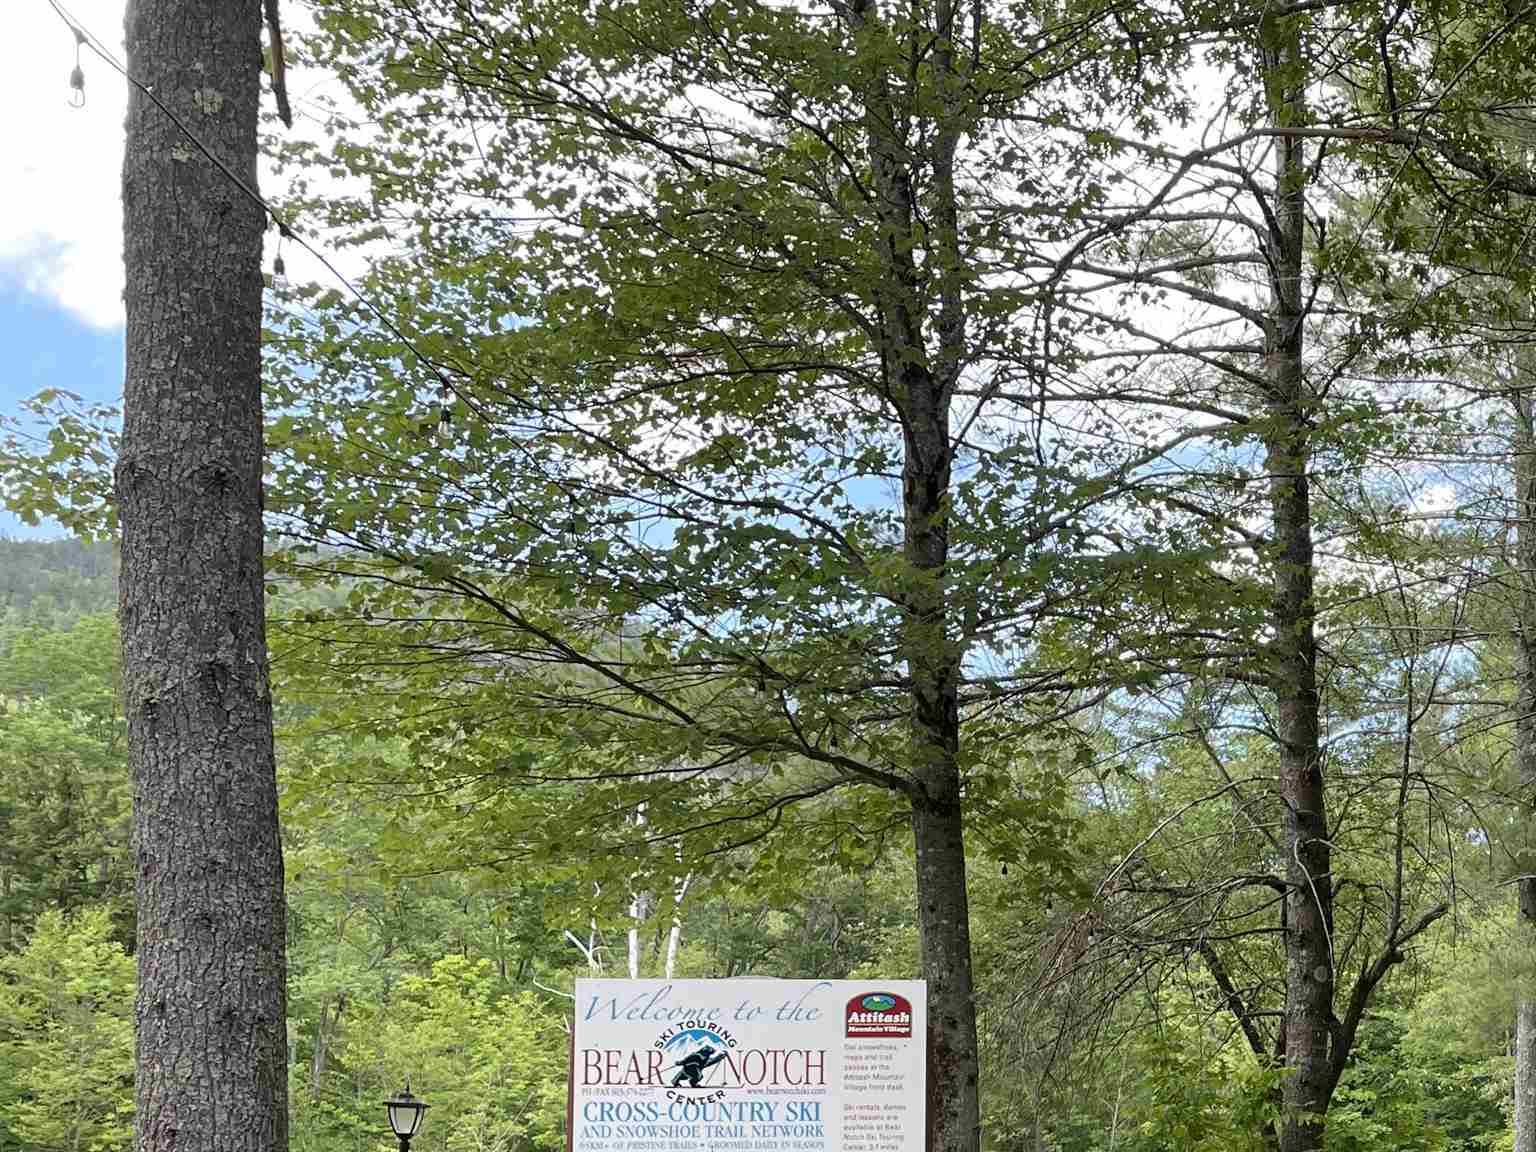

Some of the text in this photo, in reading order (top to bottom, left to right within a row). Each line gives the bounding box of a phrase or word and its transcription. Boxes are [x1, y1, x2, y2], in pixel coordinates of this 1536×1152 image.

[584, 982, 832, 1021] Welcome to the
[848, 1012, 910, 1023] Attitash
[654, 1020, 738, 1049] SKI TOURING
[580, 1048, 827, 1086] BEAR NOTCH
[666, 1090, 726, 1105] CENTER
[583, 1101, 821, 1122] CROSS-COUNTRY SKI
[580, 1125, 825, 1138] AND SNOWSHOE TRAIL NETWORK
[626, 1141, 667, 1150] PRISTINE
[672, 1141, 698, 1150] TRAILS
[707, 1141, 753, 1150] GROOMED
[755, 1141, 779, 1150] DAILY
